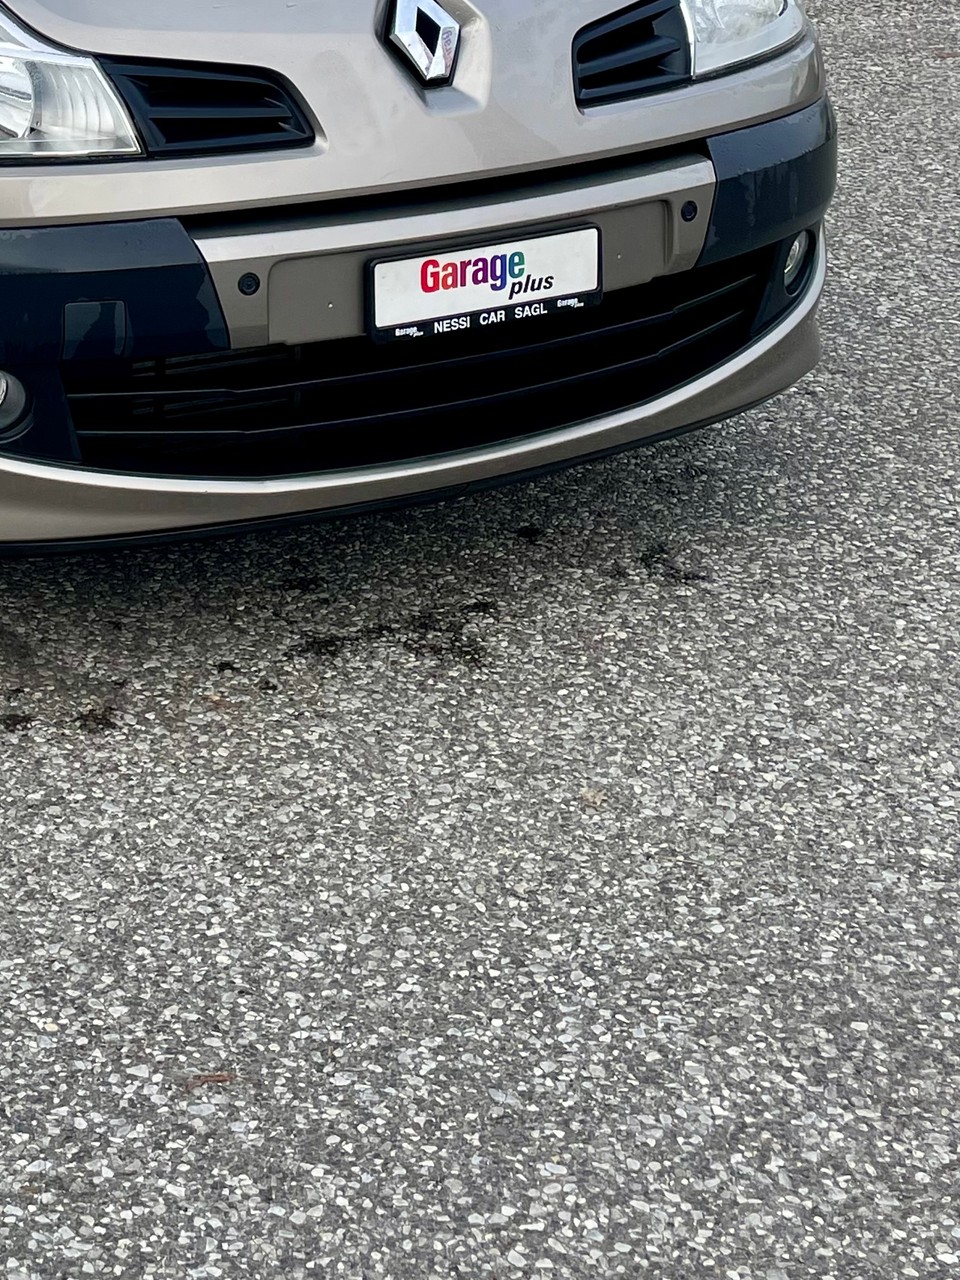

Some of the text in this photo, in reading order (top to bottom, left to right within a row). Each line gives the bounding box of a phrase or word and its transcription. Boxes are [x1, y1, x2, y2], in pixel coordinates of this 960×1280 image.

[420, 250, 525, 293] Garage
[508, 274, 555, 300] plus
[557, 297, 579, 308] Garage
[395, 326, 418, 337] Garage
[434, 303, 548, 334] NESSI CAR SAGL
